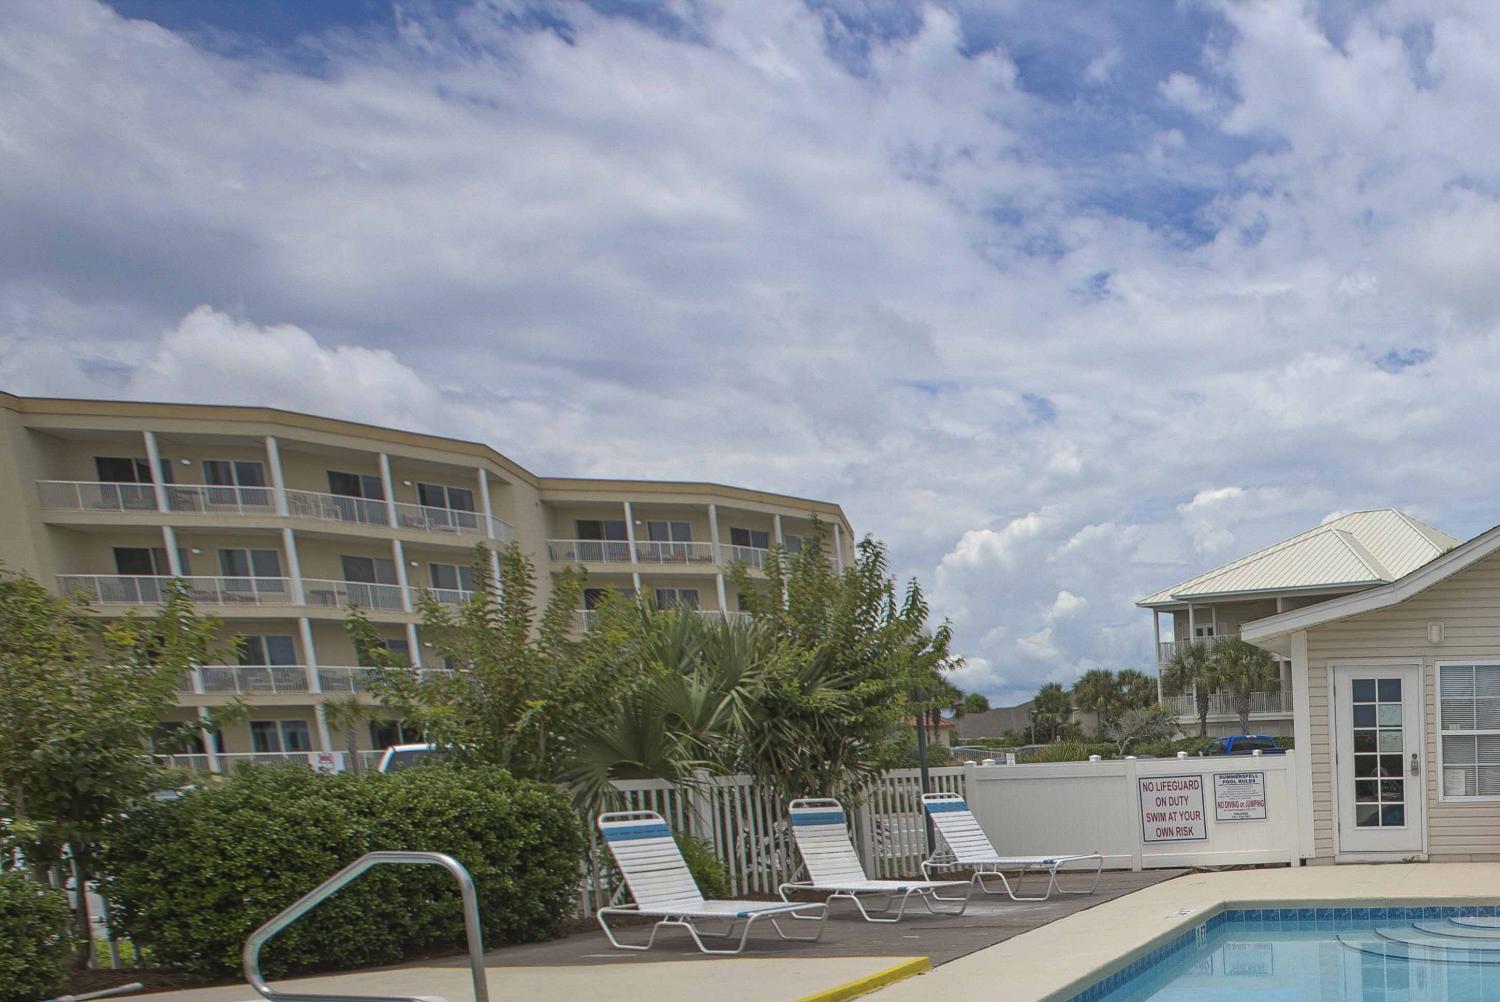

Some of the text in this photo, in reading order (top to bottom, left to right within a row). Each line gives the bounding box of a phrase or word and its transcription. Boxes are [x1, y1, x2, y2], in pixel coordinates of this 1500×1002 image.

[1142, 780, 1199, 792] NO LIFEGUARD
[1155, 795, 1188, 807] ON DUTY
[1225, 800, 1240, 808] DIVING
[1245, 799, 1265, 808] JUMPING
[1146, 810, 1201, 823] SWIM AT YOUR
[1155, 826, 1194, 837] OWN RISK
